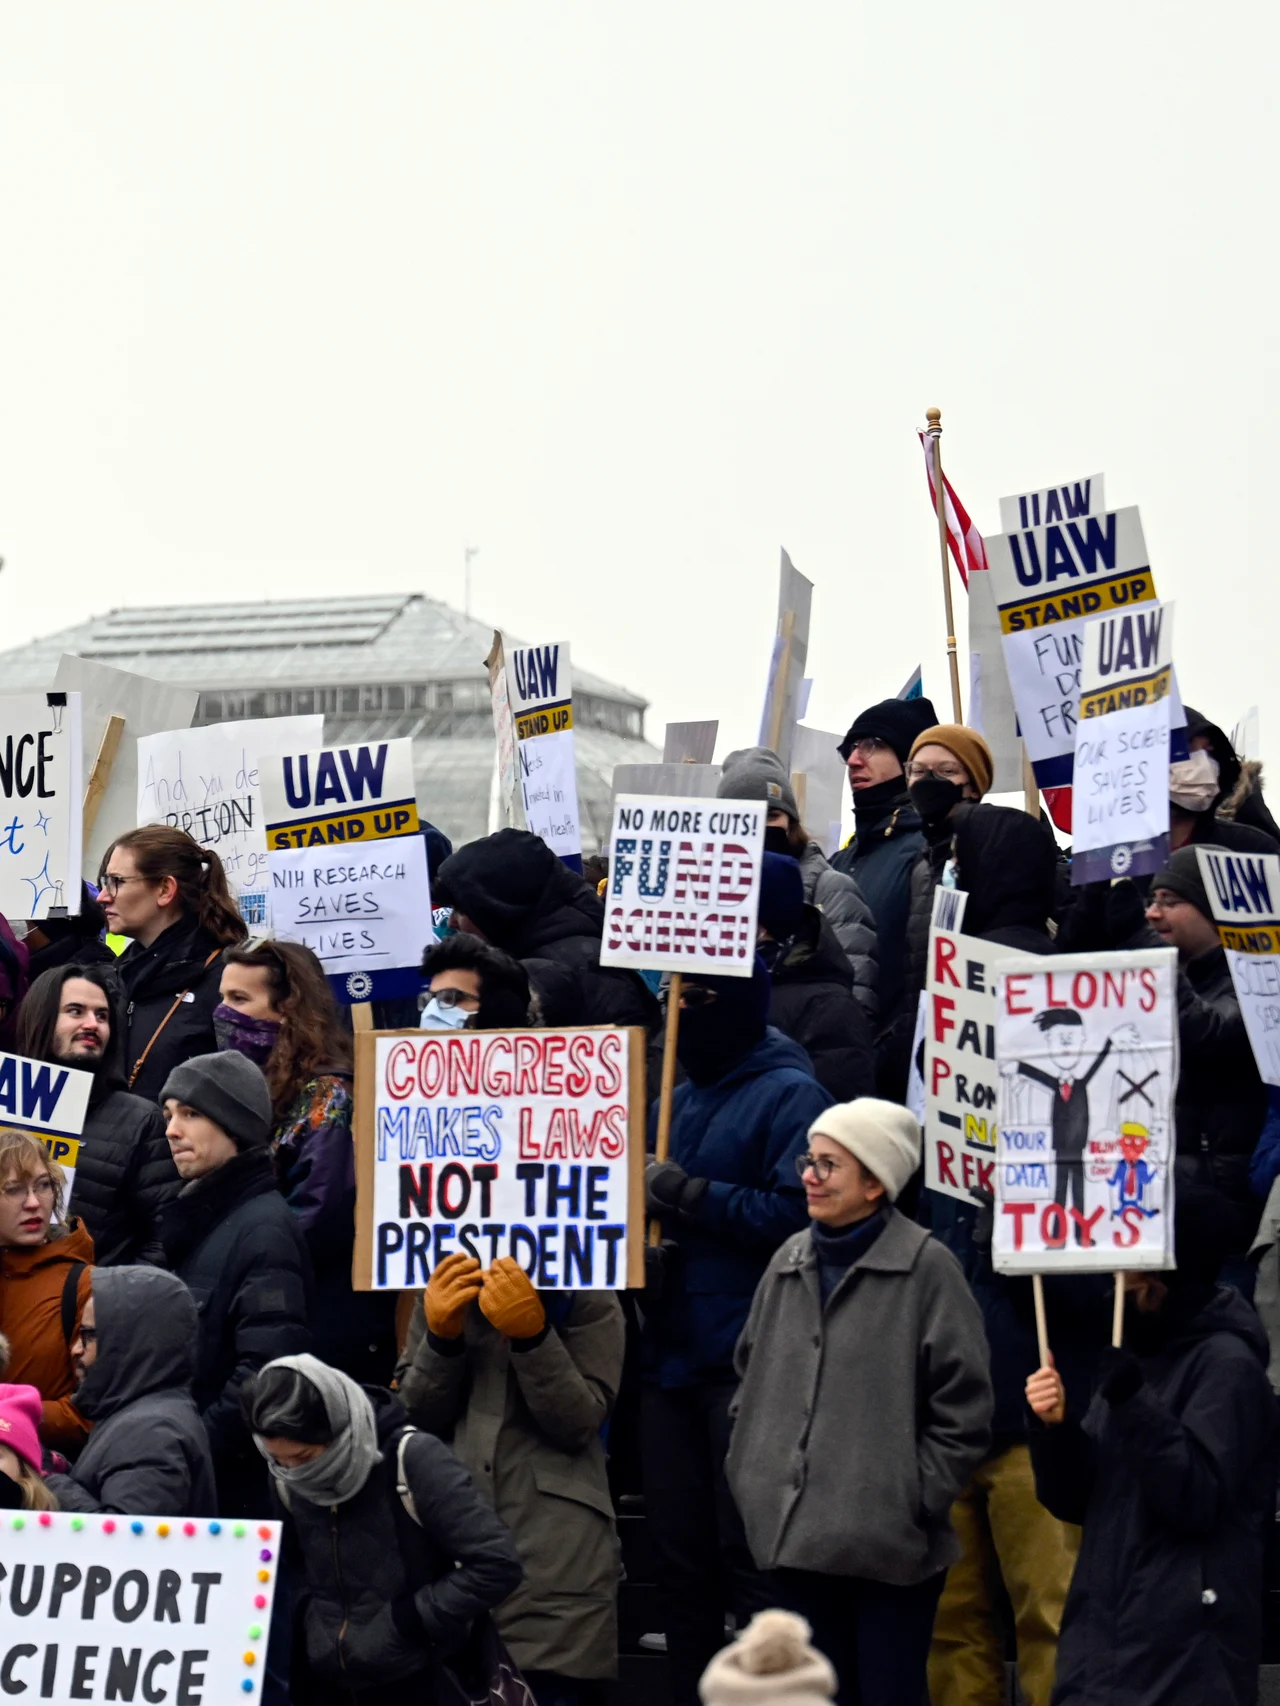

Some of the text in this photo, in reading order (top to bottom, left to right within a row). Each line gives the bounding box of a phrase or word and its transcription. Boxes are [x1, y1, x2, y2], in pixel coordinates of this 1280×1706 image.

[1008, 513, 1117, 588] UAW
[1009, 580, 1147, 632] STAND UP
[1098, 607, 1163, 676] UAW
[514, 645, 559, 700] UAW
[518, 710, 568, 739] STAND UP
[1084, 687, 1147, 719] STAND
[282, 744, 388, 810] UAW
[1077, 741, 1106, 768] OUR
[1090, 760, 1149, 796] SAVES
[141, 754, 189, 808] And
[274, 811, 411, 850] STAND UP
[619, 808, 758, 837] NO MORE CUTS!
[1087, 790, 1148, 824] LIVES
[272, 864, 406, 889] NIH RESEARCH
[612, 838, 754, 907] FUND
[1206, 854, 1274, 914] UAW
[298, 892, 380, 918] SAVES
[302, 930, 376, 951] LIVES
[608, 907, 750, 958] SCIENCE!
[1224, 931, 1272, 953] STAND
[1005, 967, 1158, 1015] ELON'S
[386, 1034, 621, 1100] CONGRESS
[377, 1105, 626, 1161] MAKES LAWS
[1002, 1130, 1045, 1152] YOUR
[399, 1162, 609, 1220] NOT THE
[1005, 1164, 1050, 1189] DATA
[1002, 1202, 1144, 1251] TOYS
